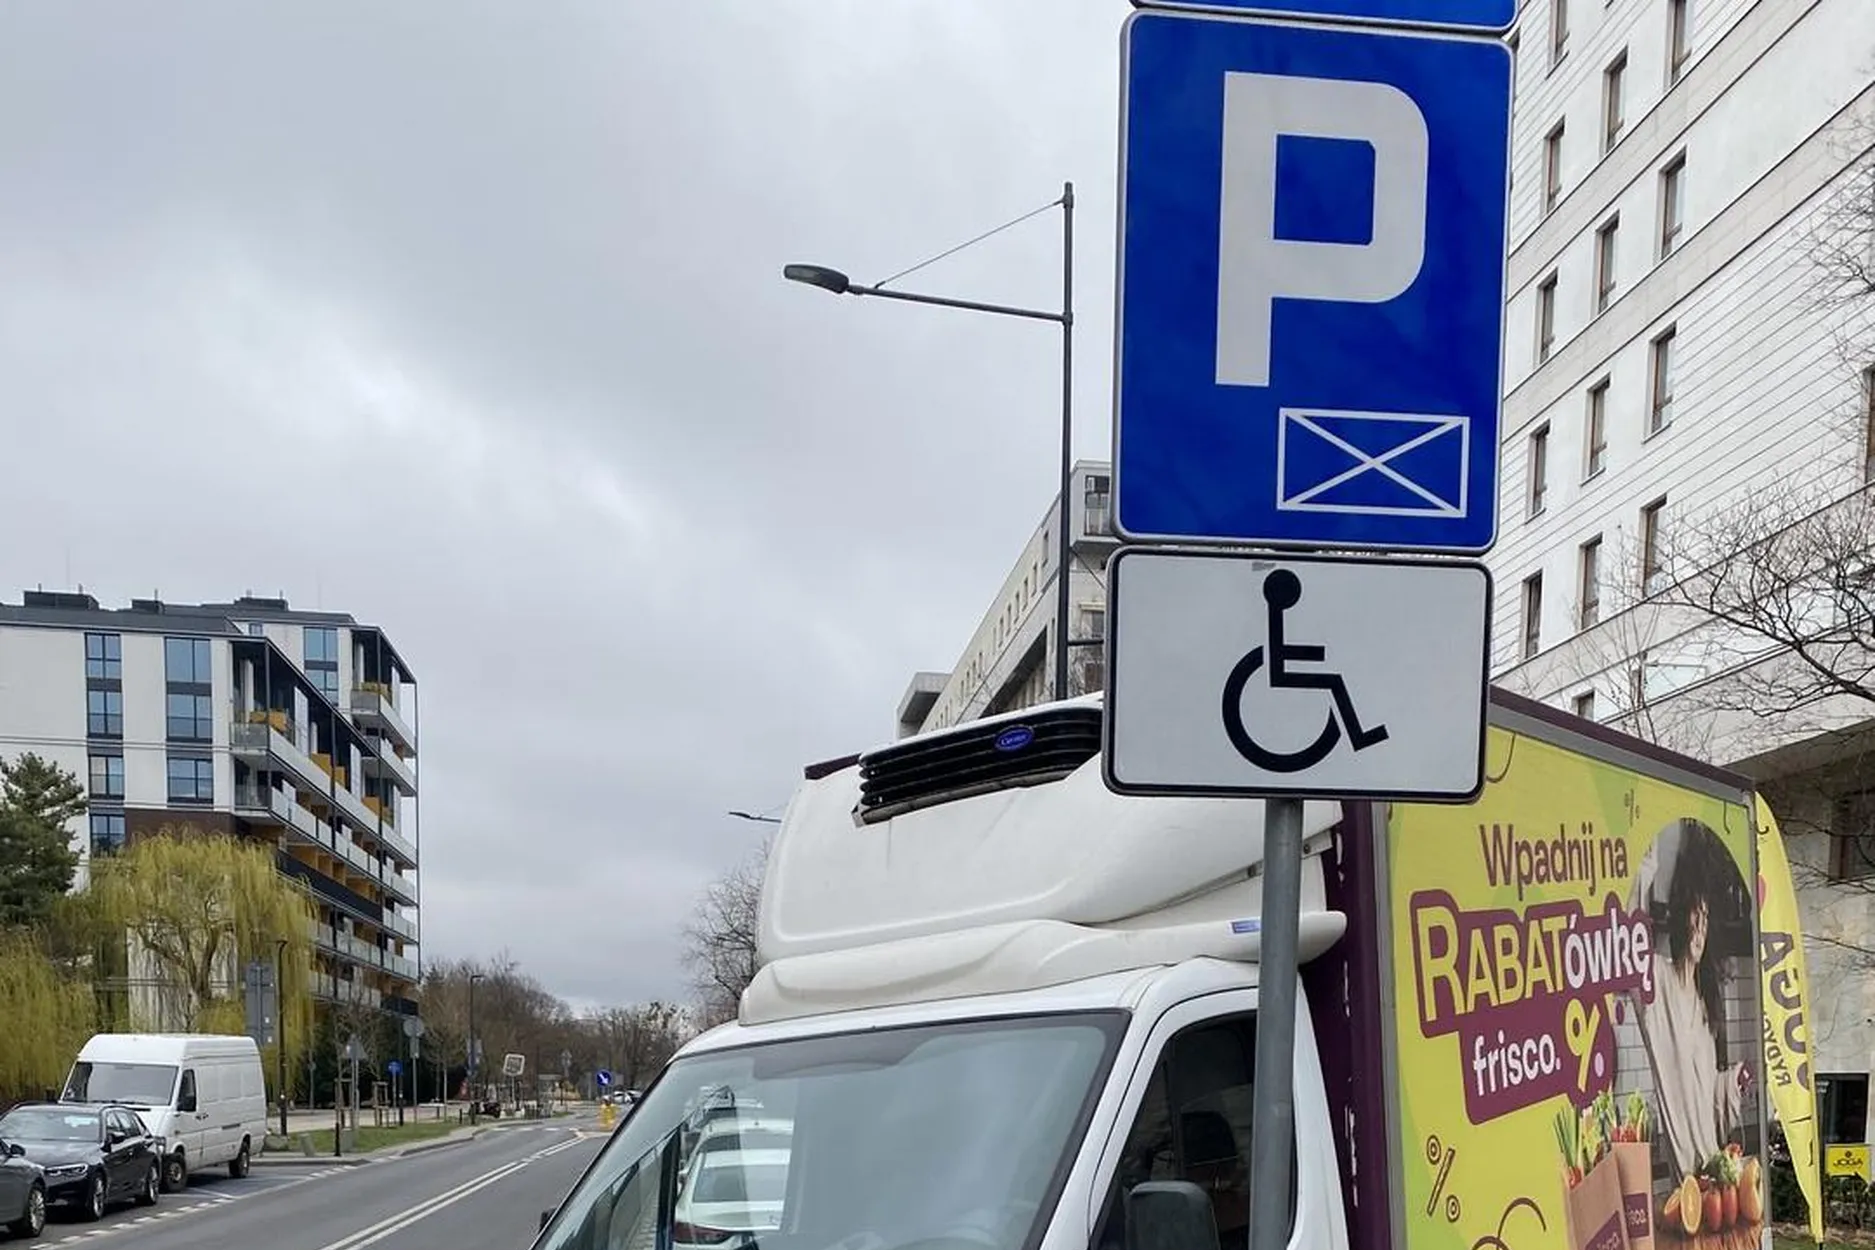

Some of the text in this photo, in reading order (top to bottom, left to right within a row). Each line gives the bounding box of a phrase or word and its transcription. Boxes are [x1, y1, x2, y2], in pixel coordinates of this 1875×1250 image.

[1214, 71, 1430, 388] P
[1479, 821, 1628, 901] Wpadnij na
[1416, 904, 1652, 1022] RABATówkę
[1473, 1030, 1562, 1097] frisco.
